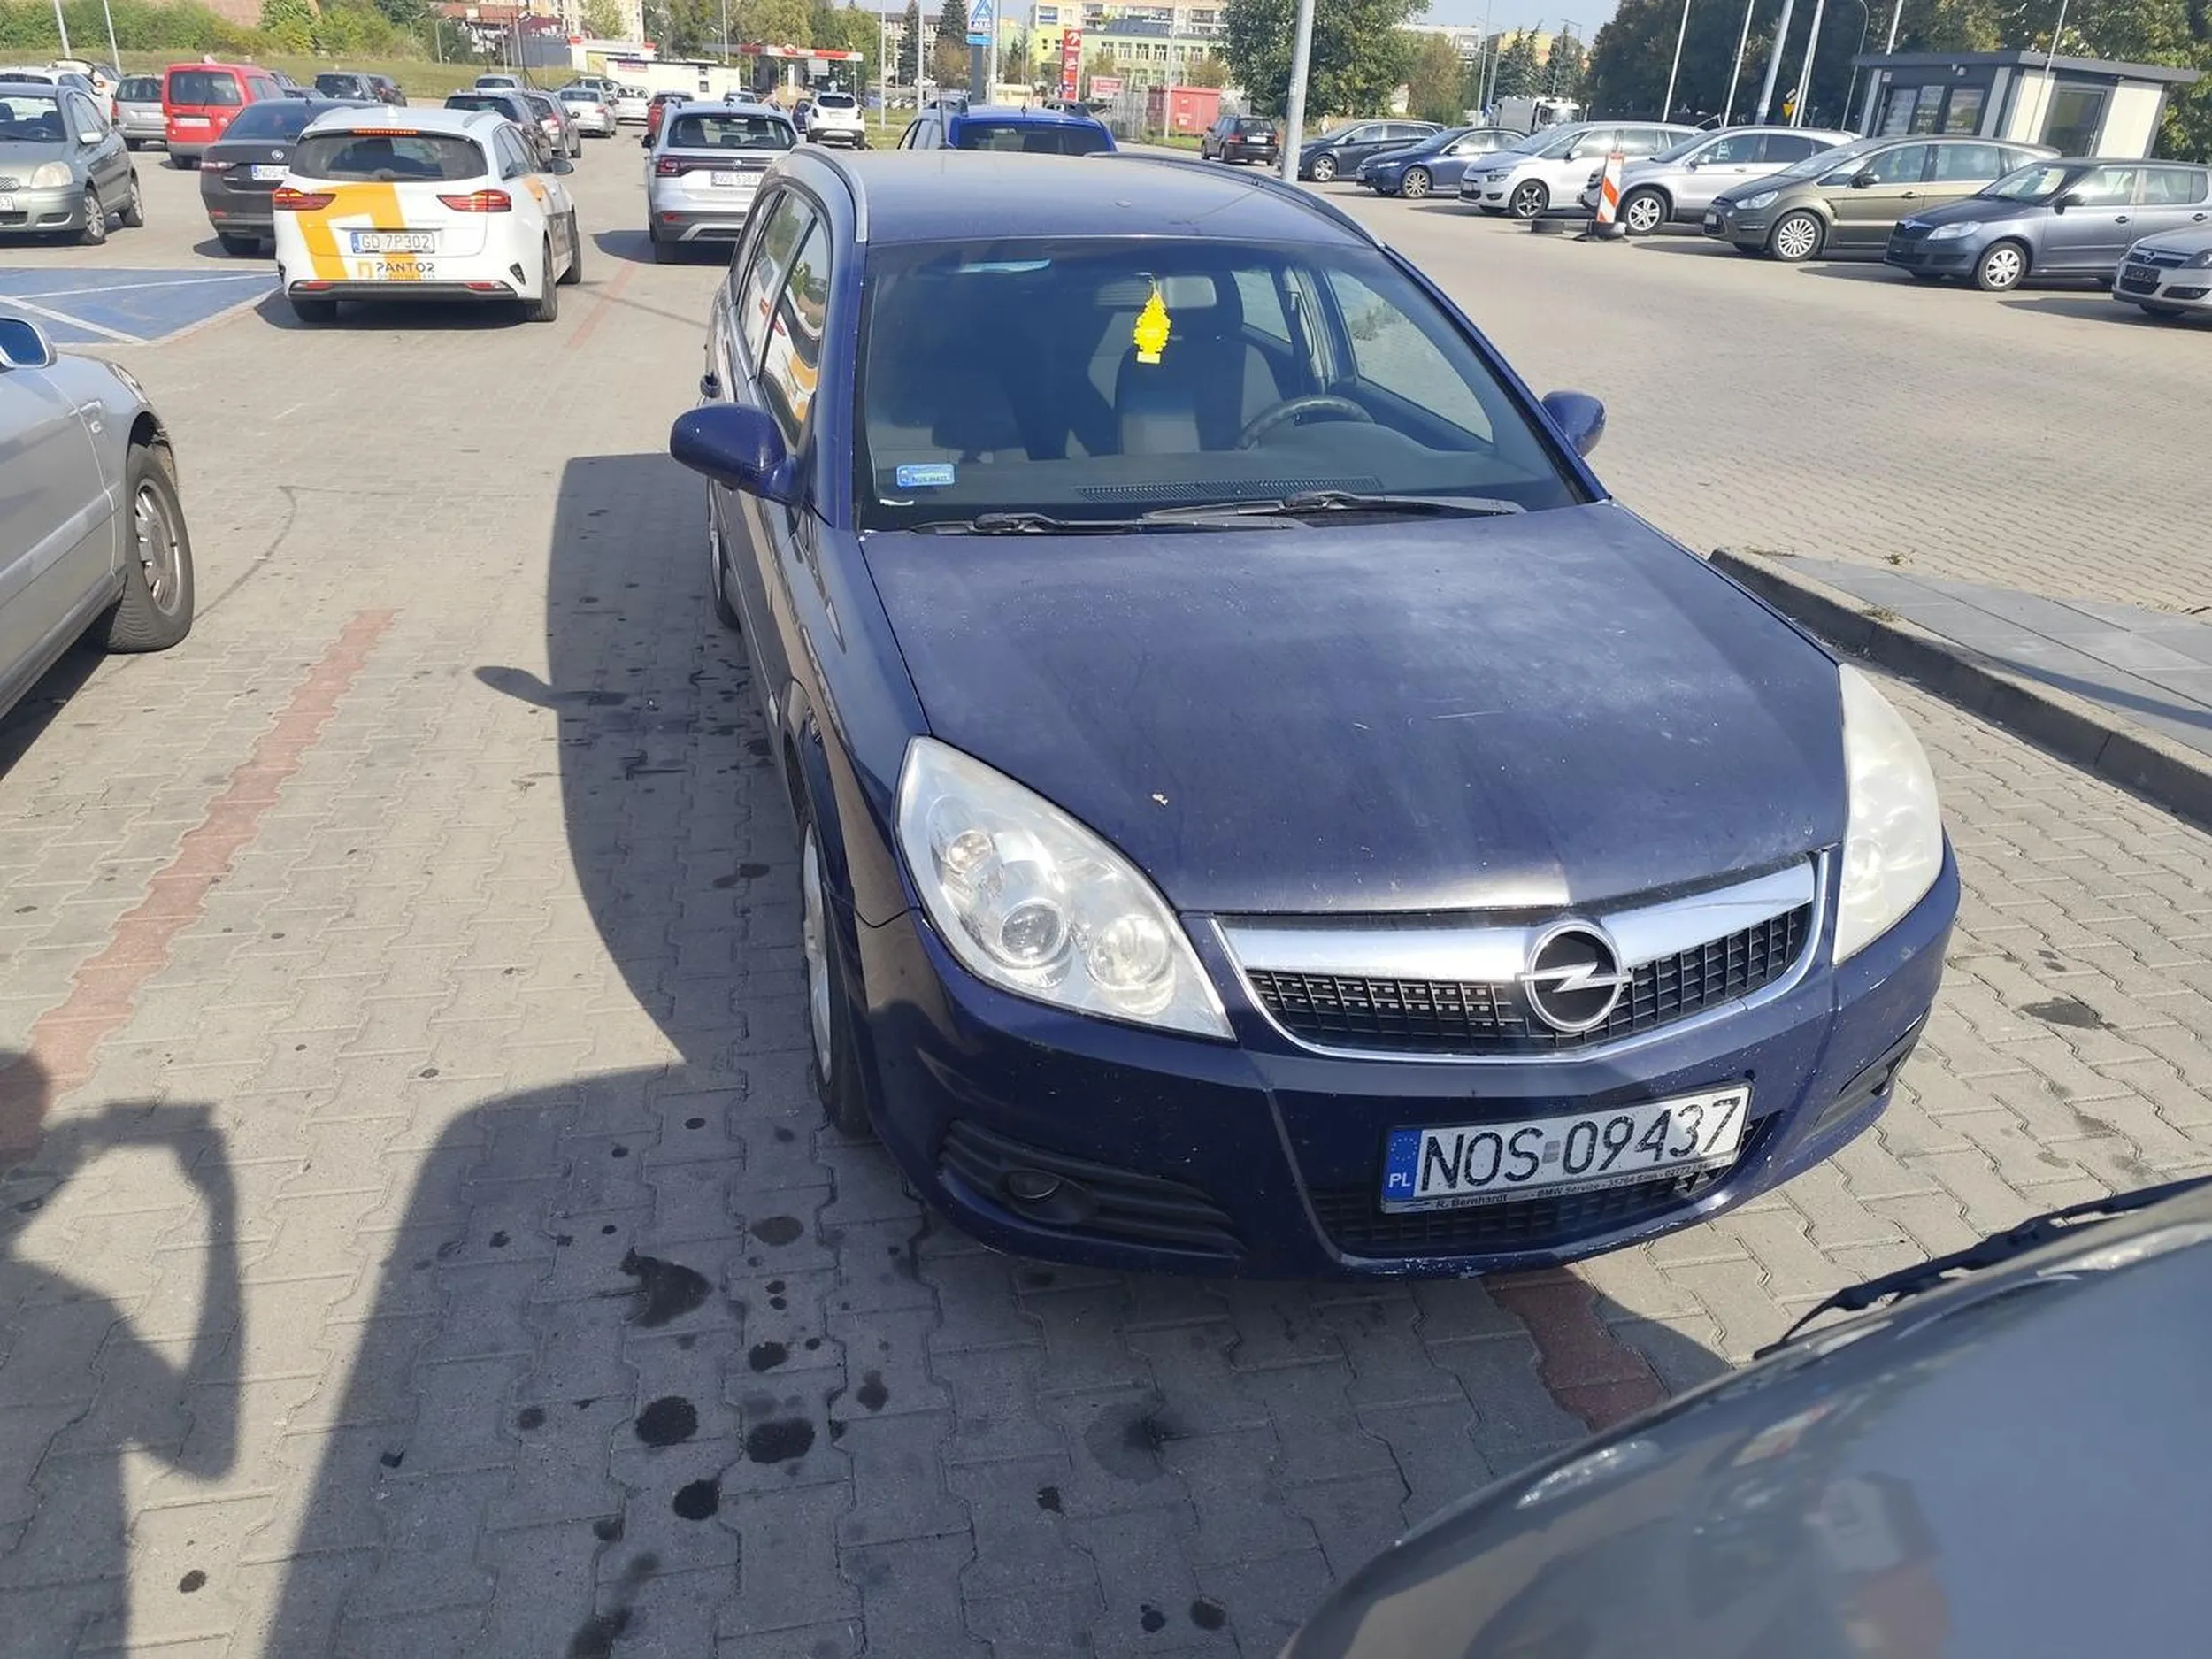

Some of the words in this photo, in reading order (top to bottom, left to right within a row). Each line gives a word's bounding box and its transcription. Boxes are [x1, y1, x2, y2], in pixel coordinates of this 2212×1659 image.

[362, 234, 380, 249] GD
[386, 234, 430, 249] 7P302
[1420, 1126, 1544, 1192] NOS
[1563, 1096, 1741, 1176] 09437
[1388, 1173, 1412, 1189] PL
[1451, 1194, 1509, 1208] Bernhardt
